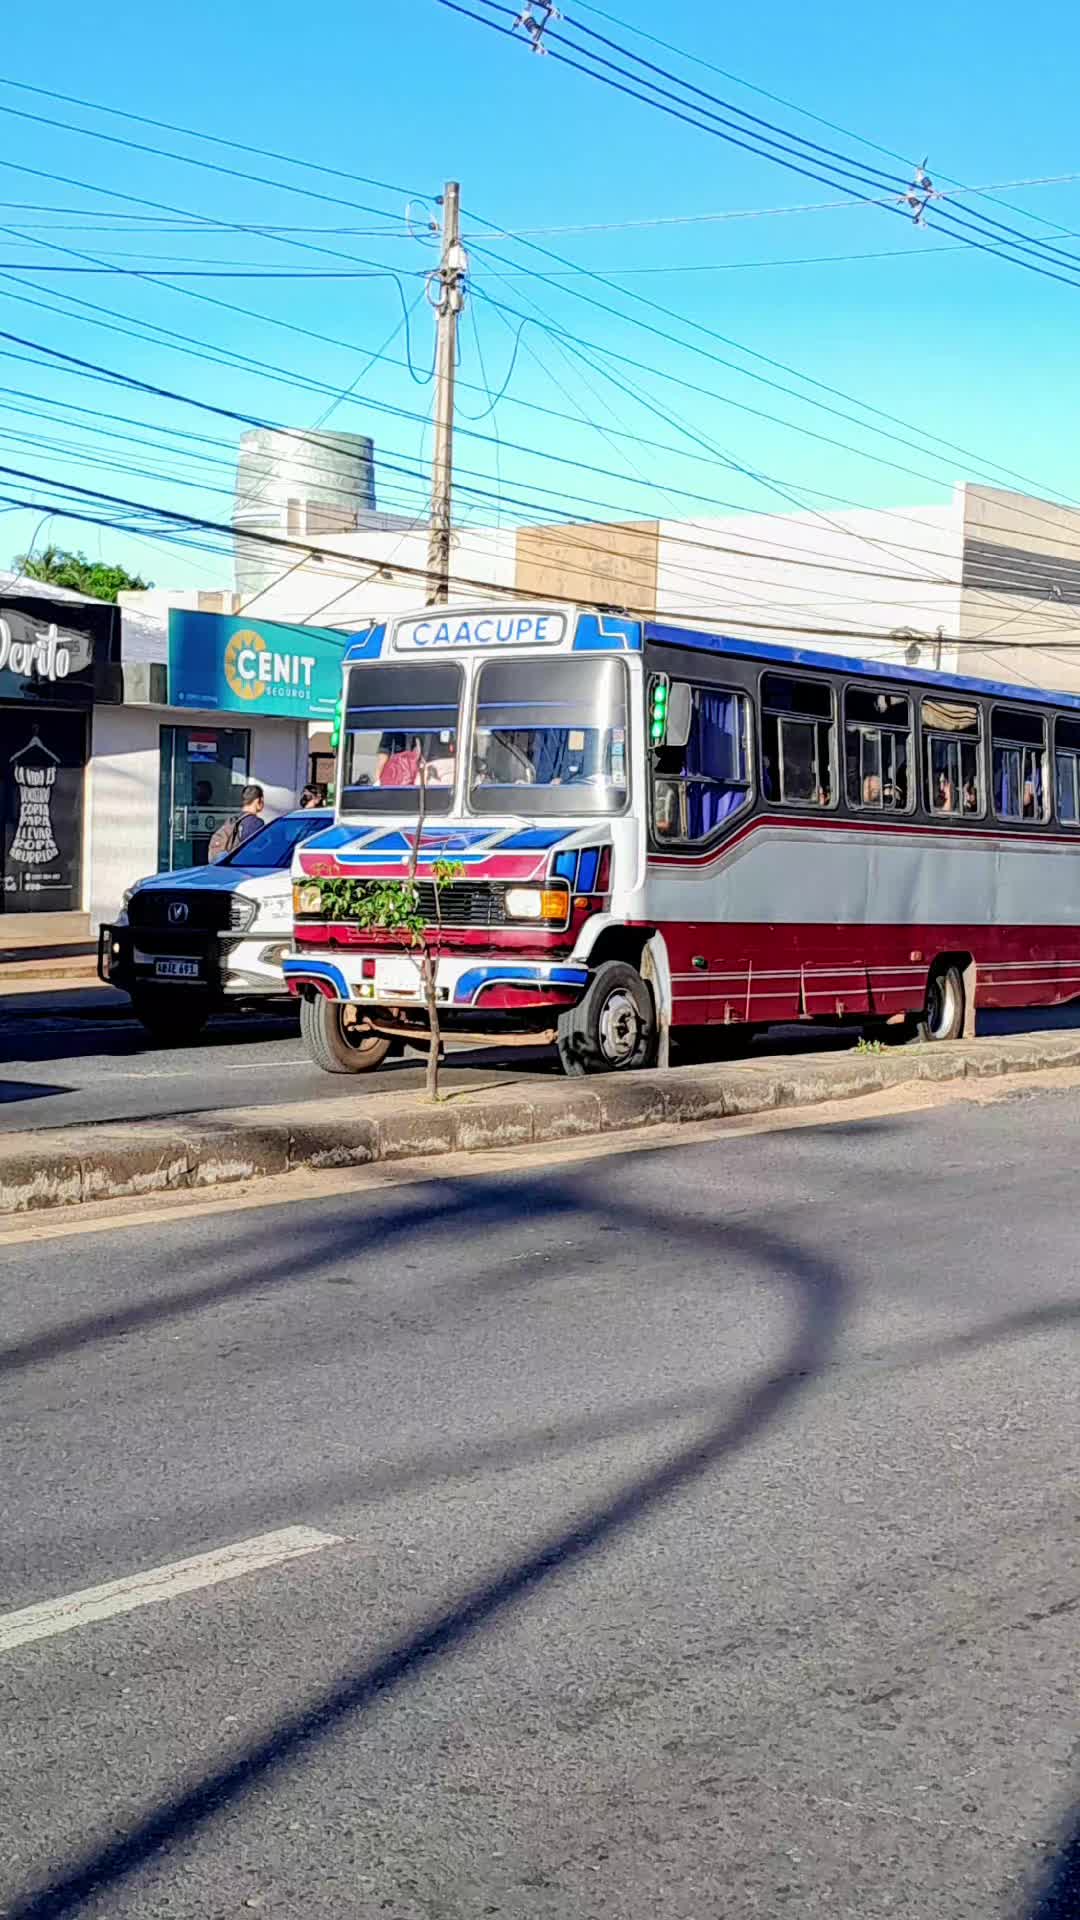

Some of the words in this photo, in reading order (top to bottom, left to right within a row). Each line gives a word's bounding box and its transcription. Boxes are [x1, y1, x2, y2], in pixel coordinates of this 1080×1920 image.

[413, 617, 549, 646] CAACUPE
[237, 649, 316, 686] CENIT
[266, 686, 311, 700] SEGUROS
